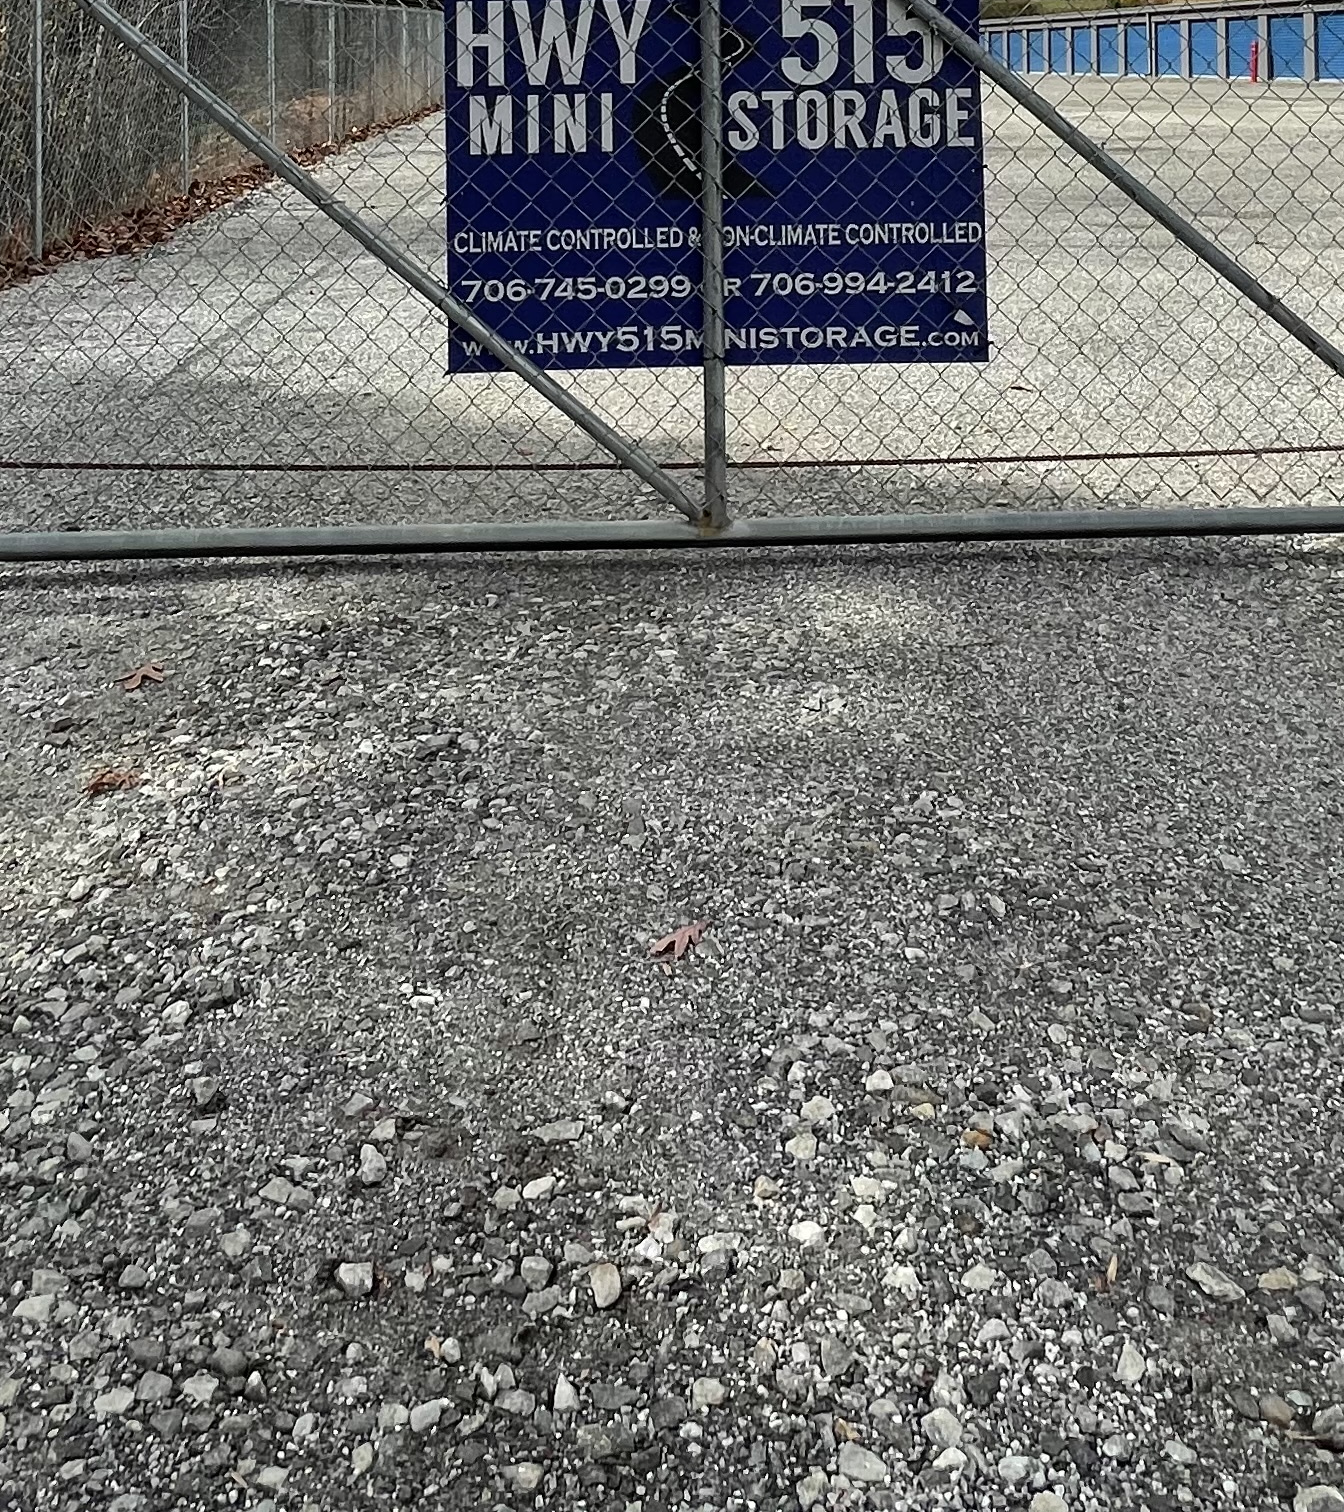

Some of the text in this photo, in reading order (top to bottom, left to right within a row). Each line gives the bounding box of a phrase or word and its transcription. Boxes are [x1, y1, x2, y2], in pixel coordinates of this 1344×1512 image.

[469, 88, 975, 155] MINI STORAGE
[454, 222, 982, 253] CLIMATE CONTROLLED & ON-CLIMATE CONTROLLED
[462, 275, 691, 303] 706-745-0299
[750, 270, 977, 297] 706-994-2412
